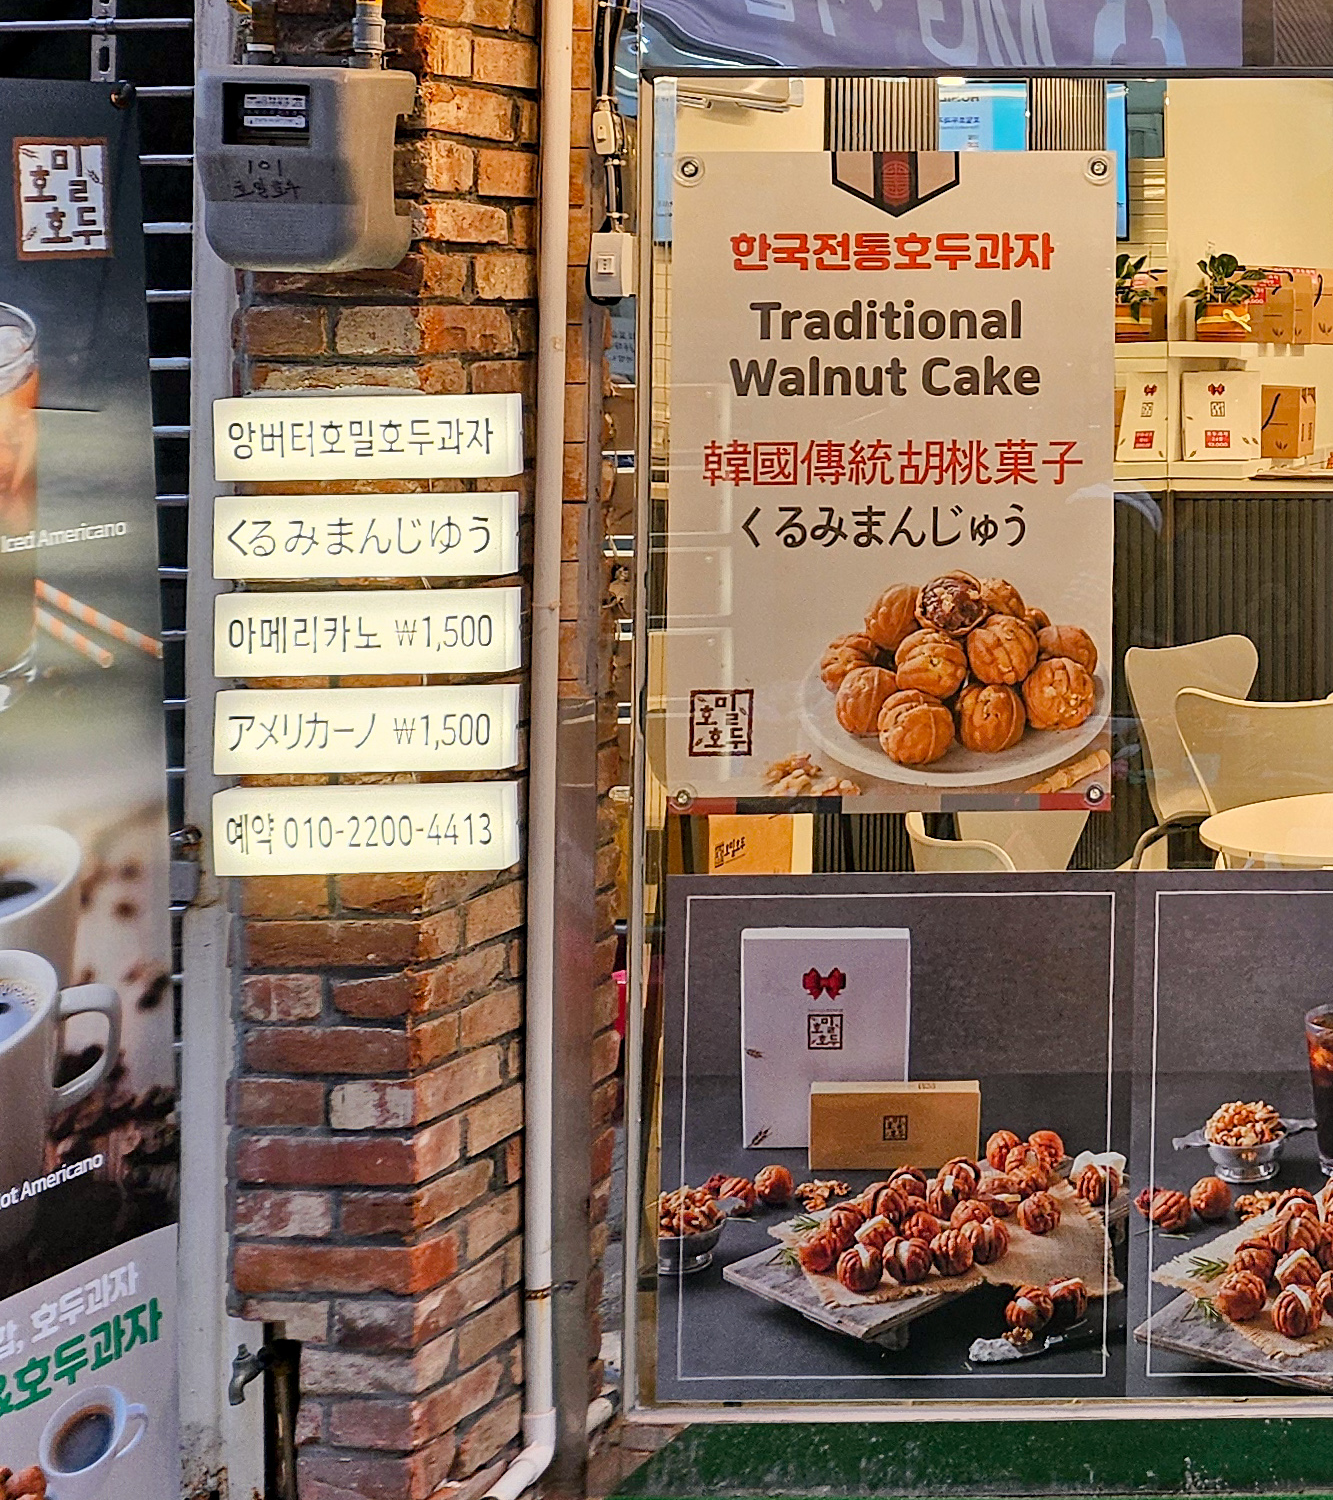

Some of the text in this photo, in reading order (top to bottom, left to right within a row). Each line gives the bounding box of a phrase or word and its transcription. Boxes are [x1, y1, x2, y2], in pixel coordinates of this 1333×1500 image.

[24, 145, 89, 202] 호밀
[40, 206, 102, 245] 호두
[729, 232, 1054, 271] 한국전통호두과자
[750, 299, 1022, 340] Traditional
[729, 355, 1041, 397] Walnut Cake
[229, 418, 493, 460] 앙버터호밀호두과자
[703, 440, 1084, 487] 韓國傳統胡桃菓子
[0, 521, 127, 553] Iced Americano
[741, 504, 1027, 547] くるみまんじゅう
[229, 614, 493, 654] 아메리카노 ₩1,500
[695, 695, 738, 726] 호밀
[228, 713, 491, 750] アメリカーノ ₩1,500
[704, 728, 746, 749] 호두
[226, 813, 492, 855] 예약 010-2200-4413
[0, 1153, 104, 1210] ot Americano
[30, 1261, 139, 1344] 호두과자
